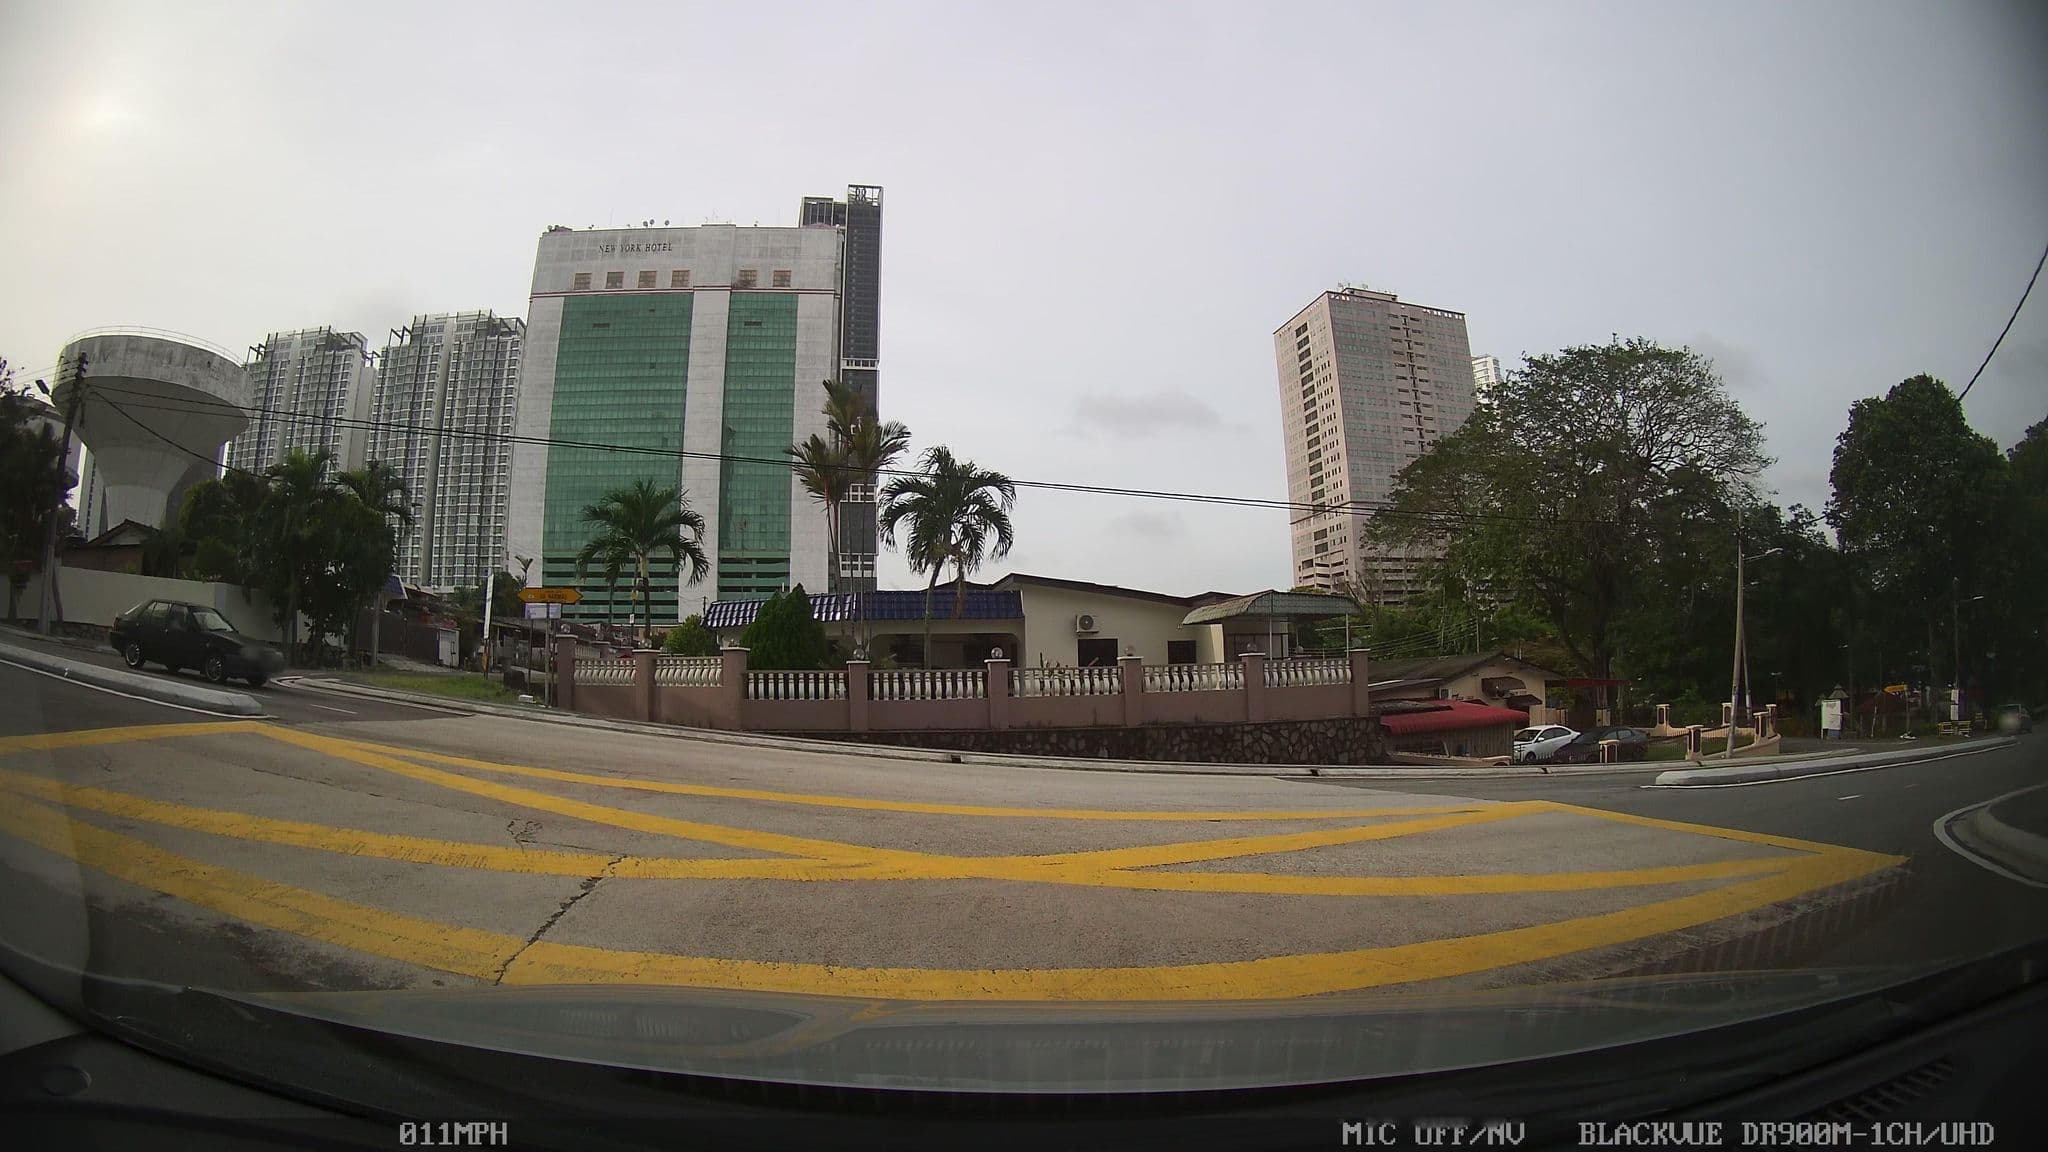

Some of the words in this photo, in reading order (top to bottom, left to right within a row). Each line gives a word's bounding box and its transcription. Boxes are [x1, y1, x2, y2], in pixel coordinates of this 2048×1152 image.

[599, 244, 616, 253] NEW
[620, 243, 642, 252] YORK
[645, 243, 672, 252] HOTEL
